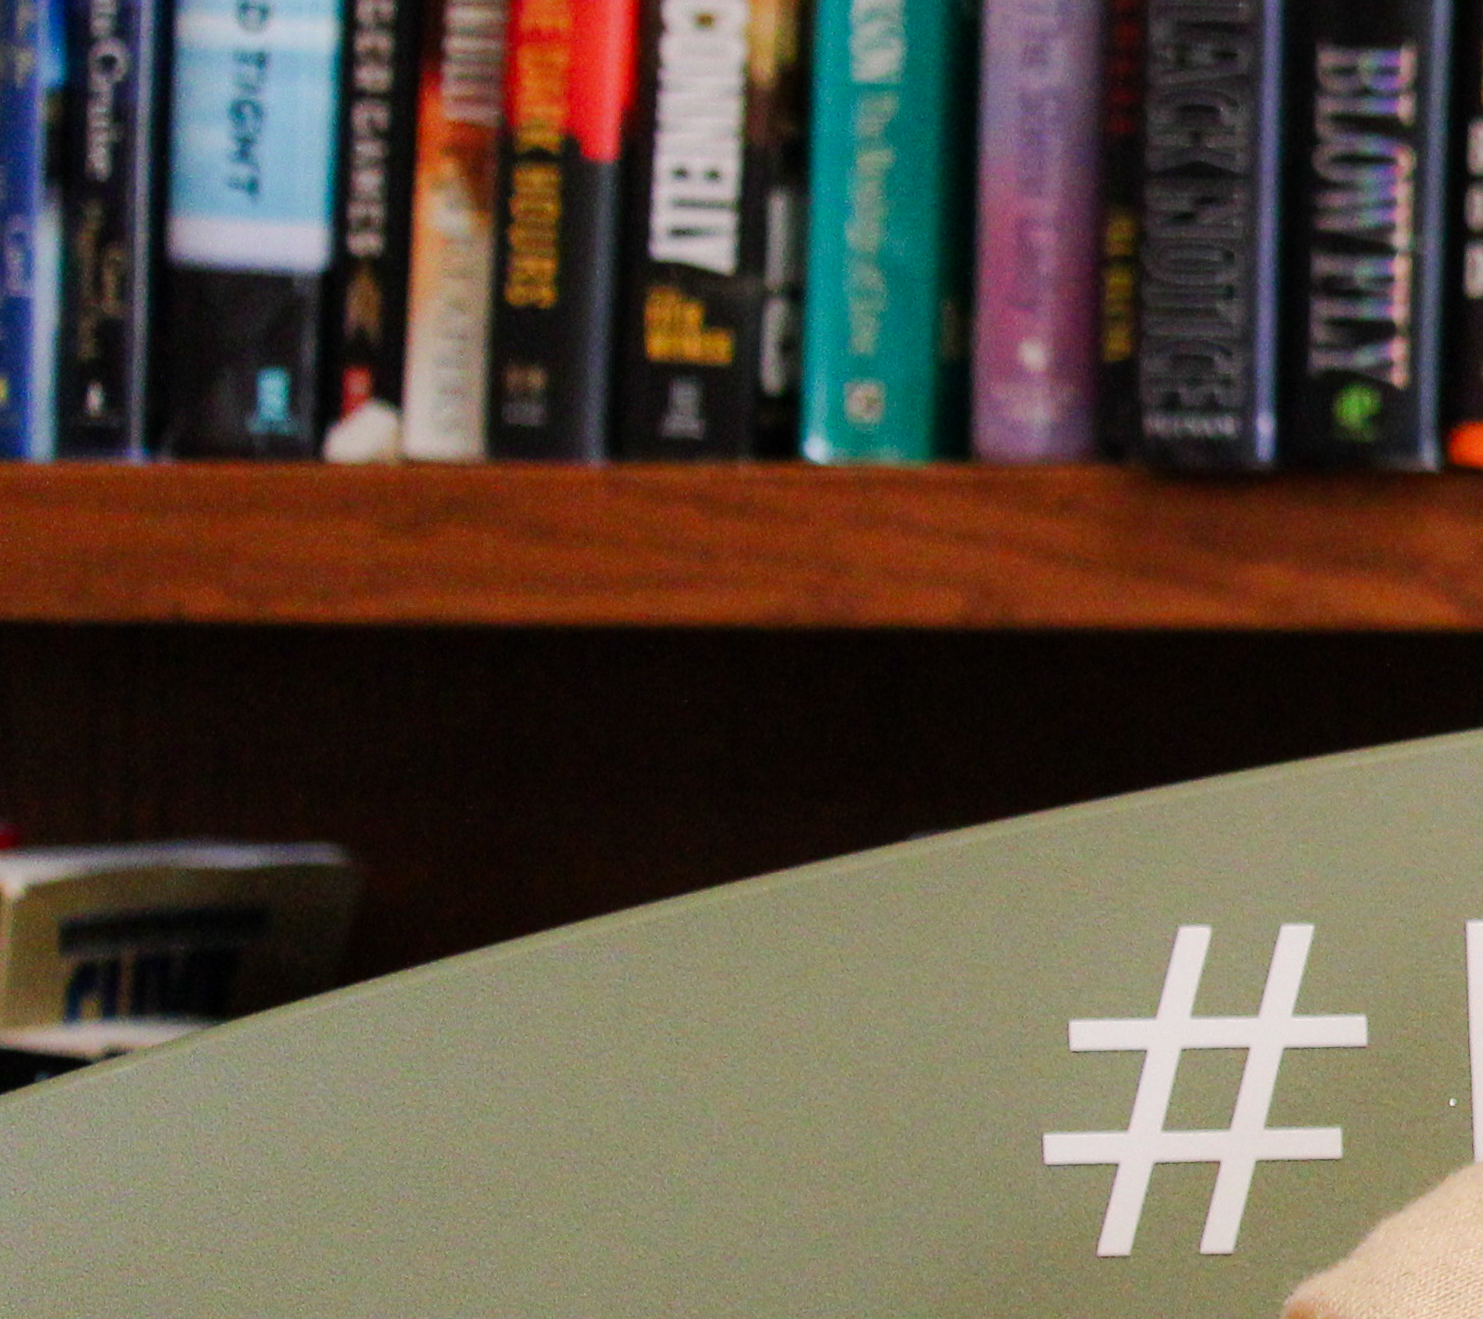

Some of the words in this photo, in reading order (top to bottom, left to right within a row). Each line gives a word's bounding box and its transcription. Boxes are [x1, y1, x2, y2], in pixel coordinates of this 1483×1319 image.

[221, 48, 268, 201] TIGHT
[347, 95, 400, 260] GAMES
[502, 160, 565, 309] HOURS
